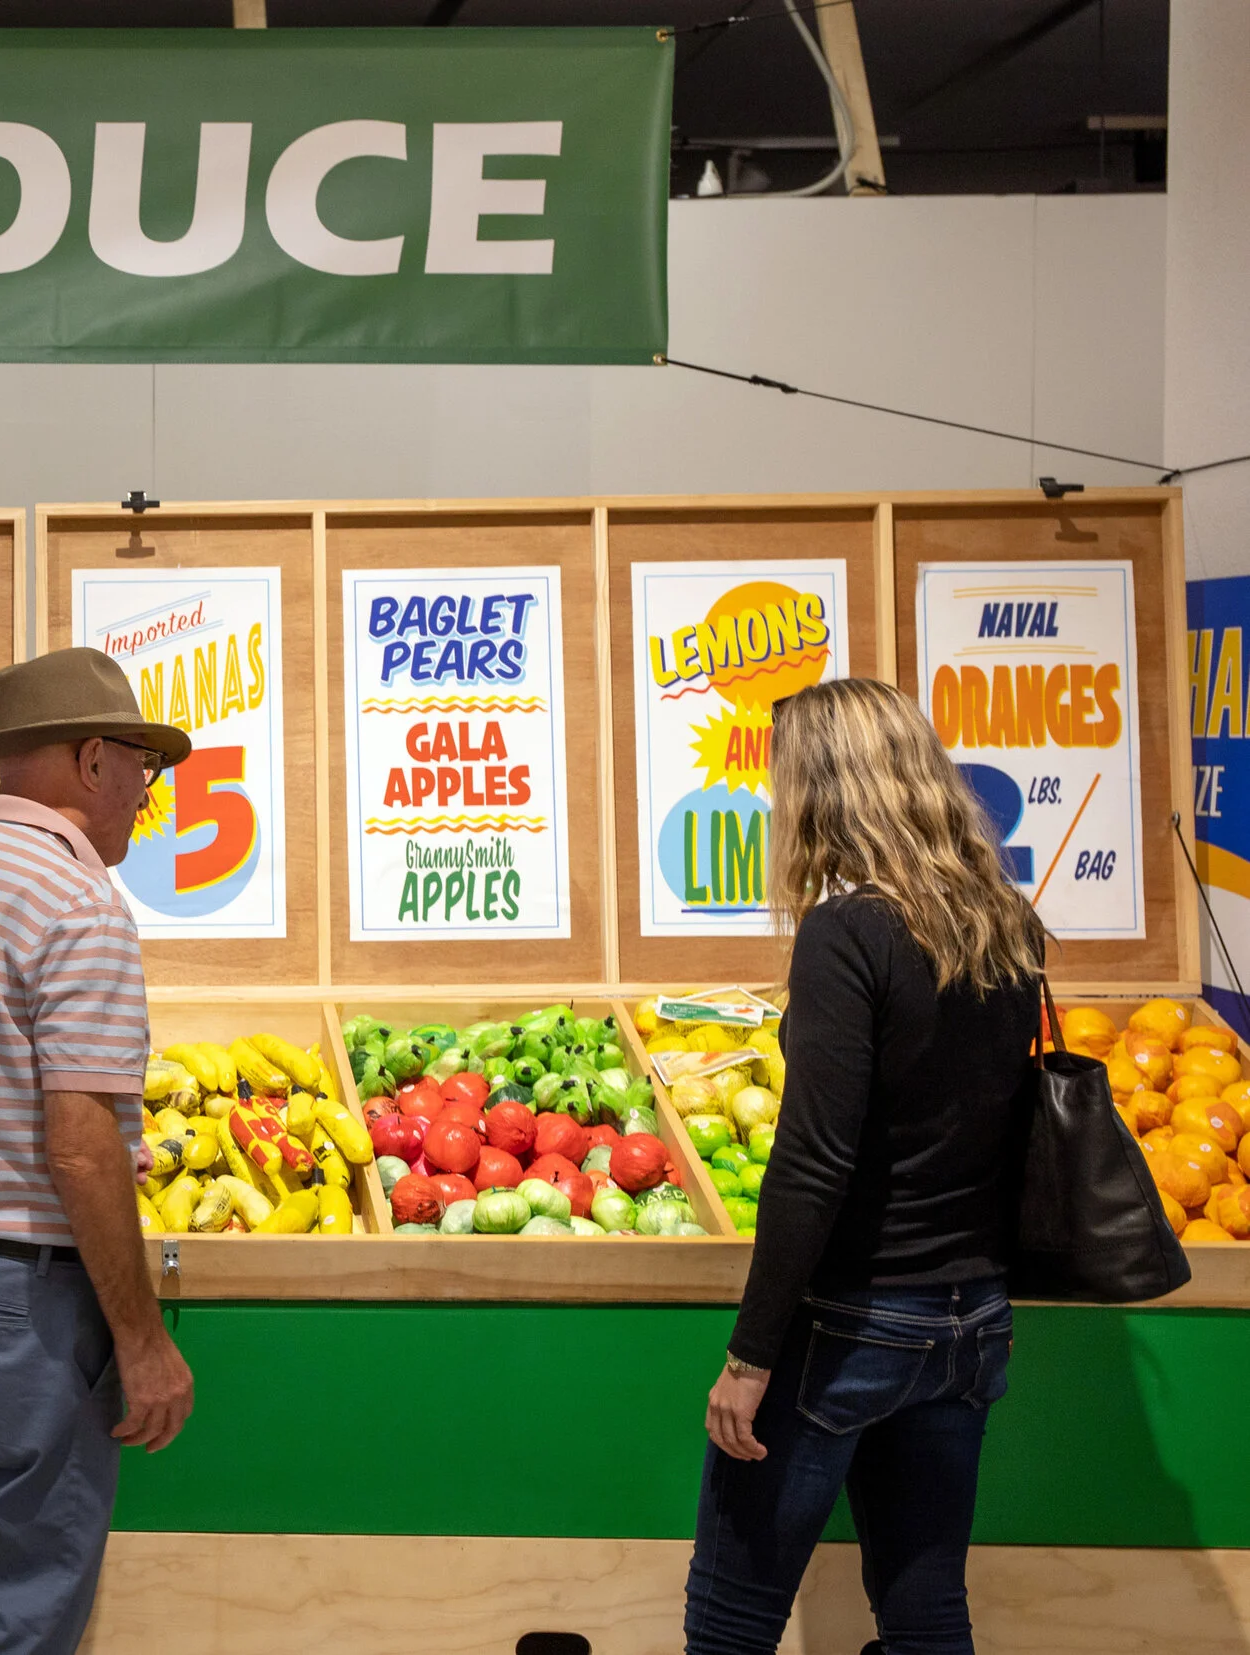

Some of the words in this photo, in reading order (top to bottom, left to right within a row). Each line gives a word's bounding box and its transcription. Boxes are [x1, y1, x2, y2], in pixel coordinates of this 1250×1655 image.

[104, 601, 205, 656] Imported
[368, 594, 536, 640] BAGLET
[649, 592, 830, 687] LEMONS
[978, 602, 1059, 638] NAVAL
[126, 622, 266, 734] NANAS
[381, 639, 525, 685] PEARS
[1187, 626, 1250, 738] HA
[932, 663, 1123, 749] ORANGES
[406, 721, 508, 762] GALA
[383, 765, 531, 808] APPLES
[1028, 777, 1062, 804] LBS.
[174, 745, 258, 895] 5
[684, 809, 773, 906] LIM
[1075, 850, 1116, 881] BAG
[398, 869, 521, 922] APPLES
